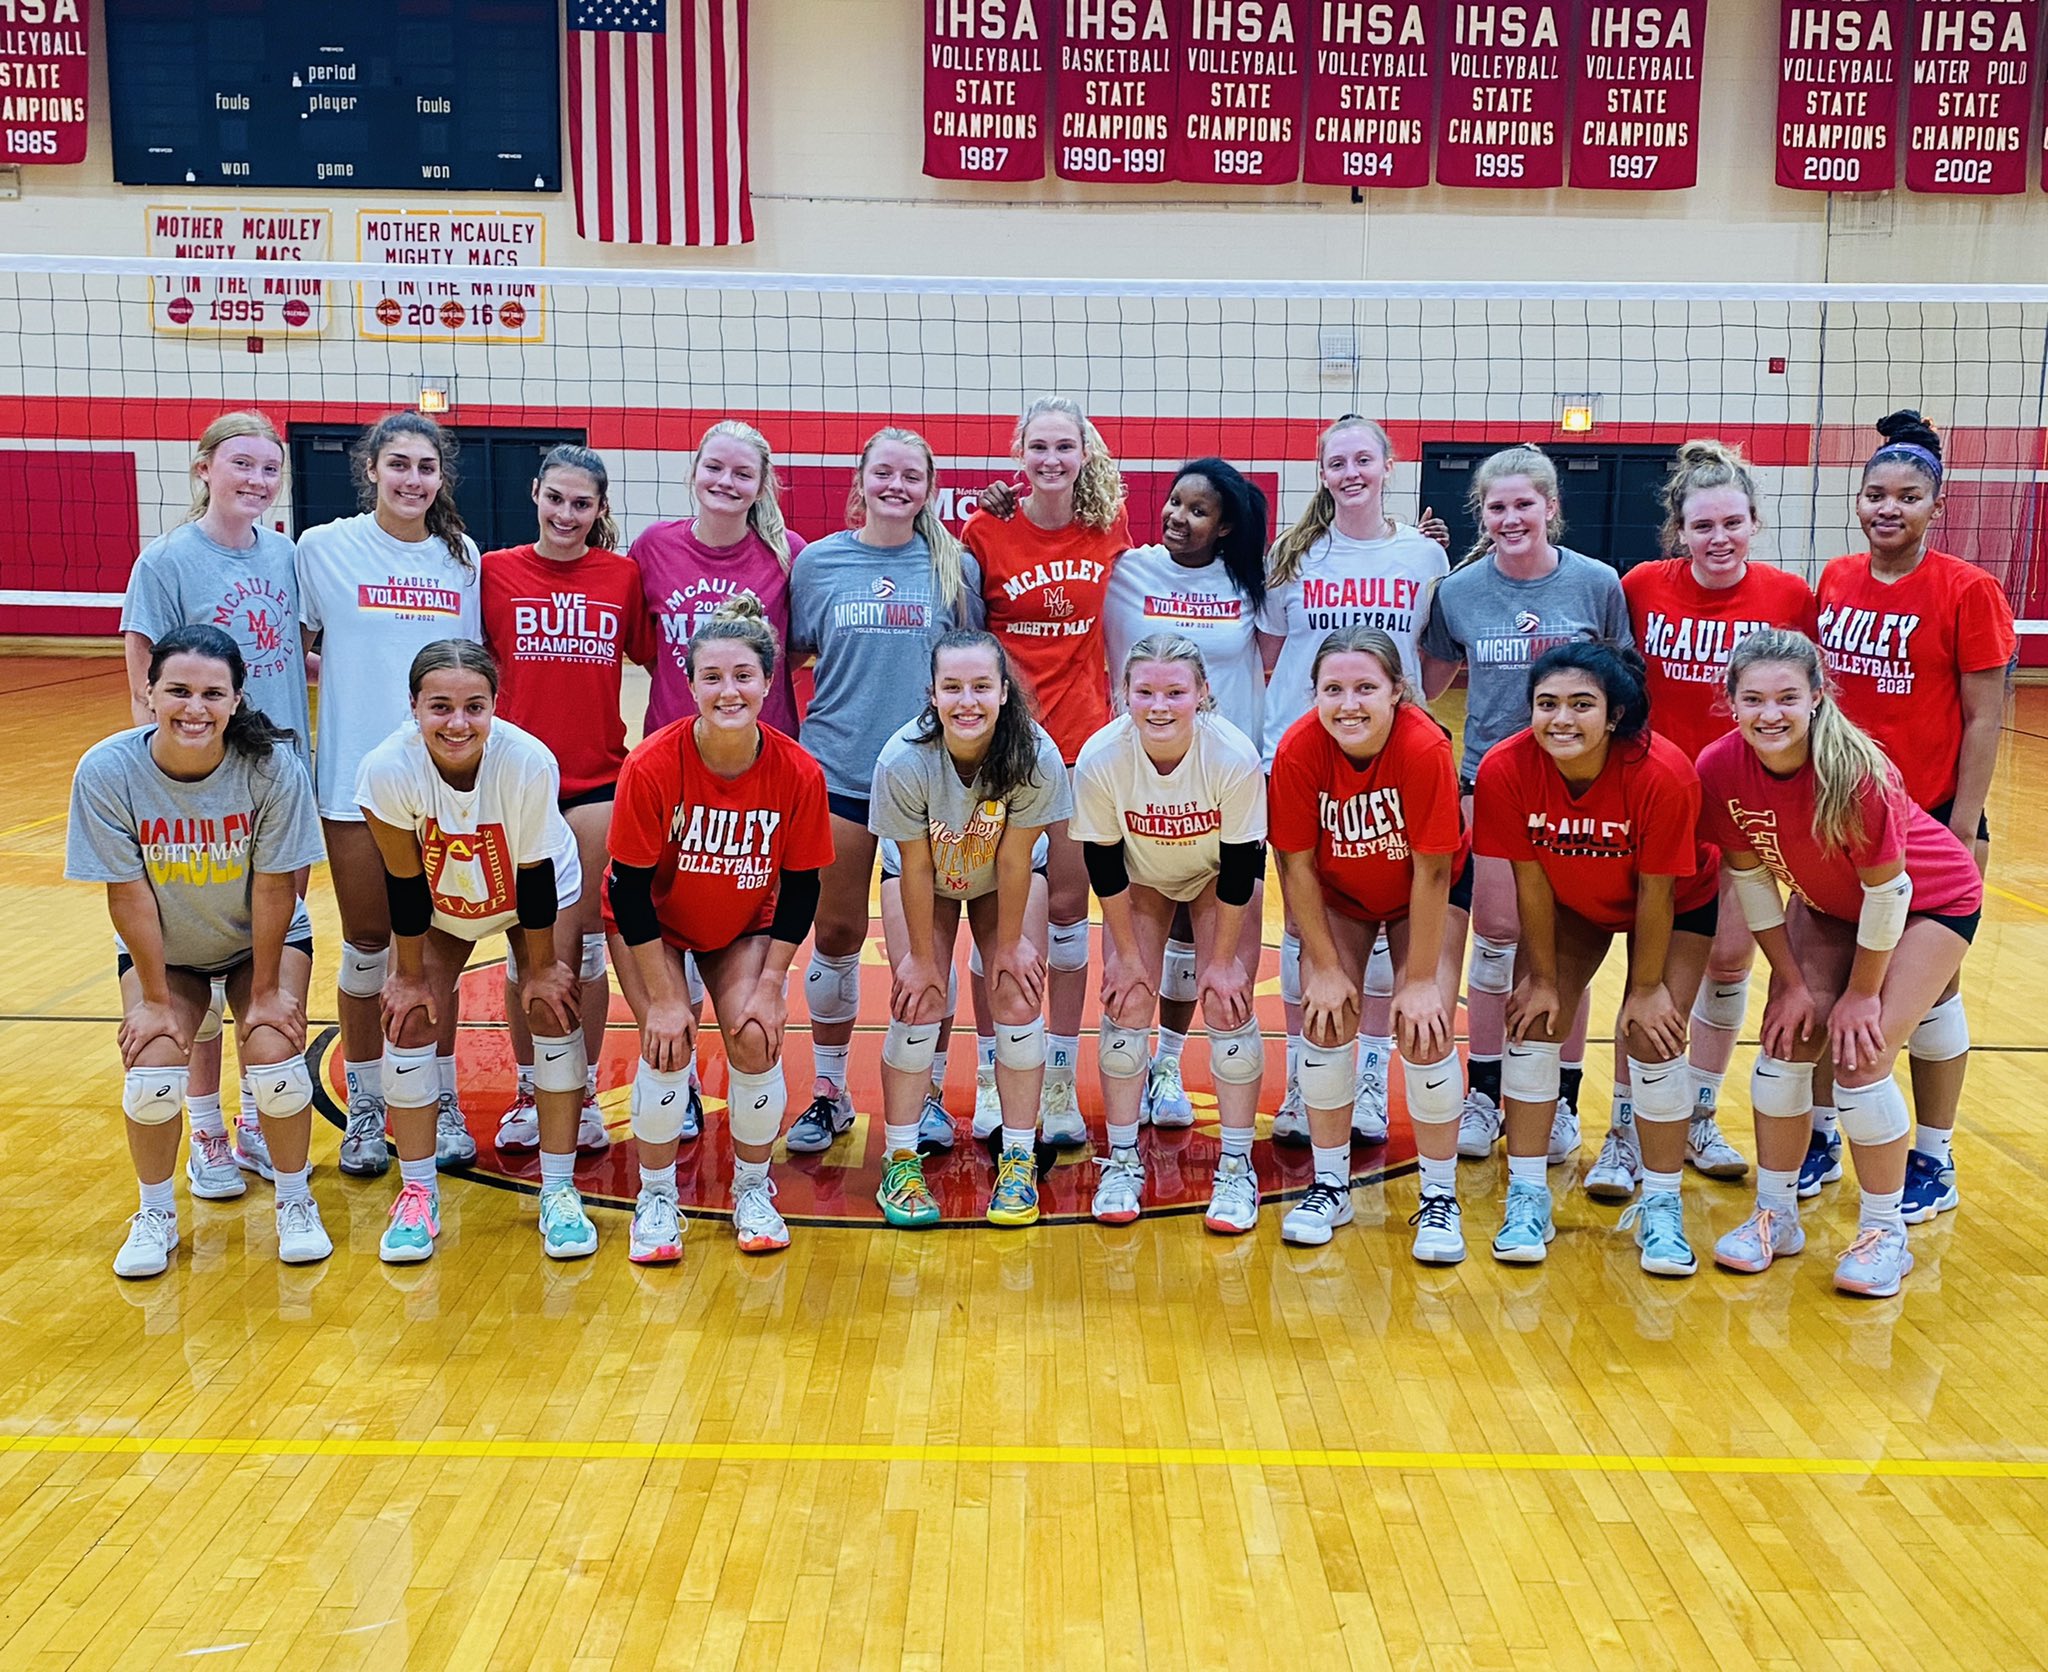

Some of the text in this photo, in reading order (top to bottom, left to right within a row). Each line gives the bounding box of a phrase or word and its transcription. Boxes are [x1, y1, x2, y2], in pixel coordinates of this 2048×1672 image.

[936, 0, 1038, 39] IHSA
[1067, 0, 1168, 40] IHSA
[1193, 0, 1294, 43] IHSA
[1323, 2, 1424, 45] IHSA
[1456, 5, 1558, 47] IHSA
[1592, 8, 1690, 48] IHSA
[1789, 9, 1892, 51] IHSA
[1921, 11, 2026, 52] IHSA
[0, 31, 86, 55] LEYBALL
[931, 44, 1042, 72] VOLLEYBALL
[1062, 46, 1170, 73] BASKETBALL
[1188, 48, 1298, 76] VOLLEYBALL
[1318, 50, 1428, 77] VOLLEYBALL
[1451, 52, 1559, 79] VOLLEYBALL
[1586, 54, 1695, 81] VOLLEYBALL
[1784, 58, 1893, 83] VOLLEYBALL
[0, 63, 60, 88] STATE
[308, 63, 356, 83] period
[1914, 59, 2027, 84] WATER POLO
[215, 92, 250, 110] fouls
[309, 93, 357, 113] player
[416, 96, 451, 113] fouls
[956, 79, 1016, 105] STATE
[1086, 81, 1145, 106] STATE
[1211, 82, 1271, 108] STATE
[1341, 84, 1400, 111] STATE
[1473, 87, 1532, 112] STATE
[1608, 88, 1667, 114] STATE
[1806, 91, 1868, 116] STATE
[3, 96, 85, 122] AMPIONS
[1938, 92, 2000, 118] STATE
[933, 111, 1037, 139] CHAMPIONS
[1062, 113, 1168, 139] CHAMPIONS
[1187, 115, 1292, 142] CHAMPIONS
[1315, 117, 1422, 144] CHAMPIONS
[1449, 119, 1554, 145] CHAMPIONS
[1583, 121, 1688, 147] CHAMPIONS
[1783, 123, 1886, 149] CHAMPIONS
[6, 129, 57, 154] 1985
[1912, 126, 2020, 151] CHAMPIONS
[221, 162, 250, 176] won
[959, 146, 1008, 170] 1987
[1063, 147, 1166, 172] 1990-1991
[1213, 149, 1263, 174] 1992
[1342, 152, 1393, 176] 1994
[1475, 153, 1524, 177] 1995
[1609, 155, 1658, 179] 1997
[1804, 157, 1860, 181] 2000
[317, 163, 354, 179] game
[422, 165, 450, 179] won
[1934, 159, 1992, 183] 2002
[156, 216, 321, 240] MOTHER MCAULEY
[367, 221, 535, 243] MOTHER MCAULEY
[385, 248, 518, 266] MIGHTY MACS
[210, 300, 265, 321] 1995
[408, 304, 435, 325] 20
[472, 304, 493, 325] 16
[366, 587, 457, 610] VOLLEYBALL
[551, 592, 587, 609] WE
[1151, 597, 1237, 617] VOLLEYBALL
[1303, 578, 1421, 611] McAULEY
[394, 612, 415, 621] CAMP
[515, 606, 619, 641] BUILD
[1006, 621, 1061, 637] MIGHTY
[1308, 612, 1411, 633] VOLLEYBALL
[516, 636, 616, 658] CHAMPIONS
[1662, 661, 1729, 684] VOLLEY
[1827, 651, 1915, 679] OLLEYBALL
[1876, 678, 1912, 694] 2021
[1129, 811, 1219, 837] VOLLEYBALL
[141, 835, 250, 863] IGHTY MAC
[678, 852, 773, 877] OLLEYBALL
[736, 874, 769, 889] 2021
[437, 894, 507, 914] AMP
